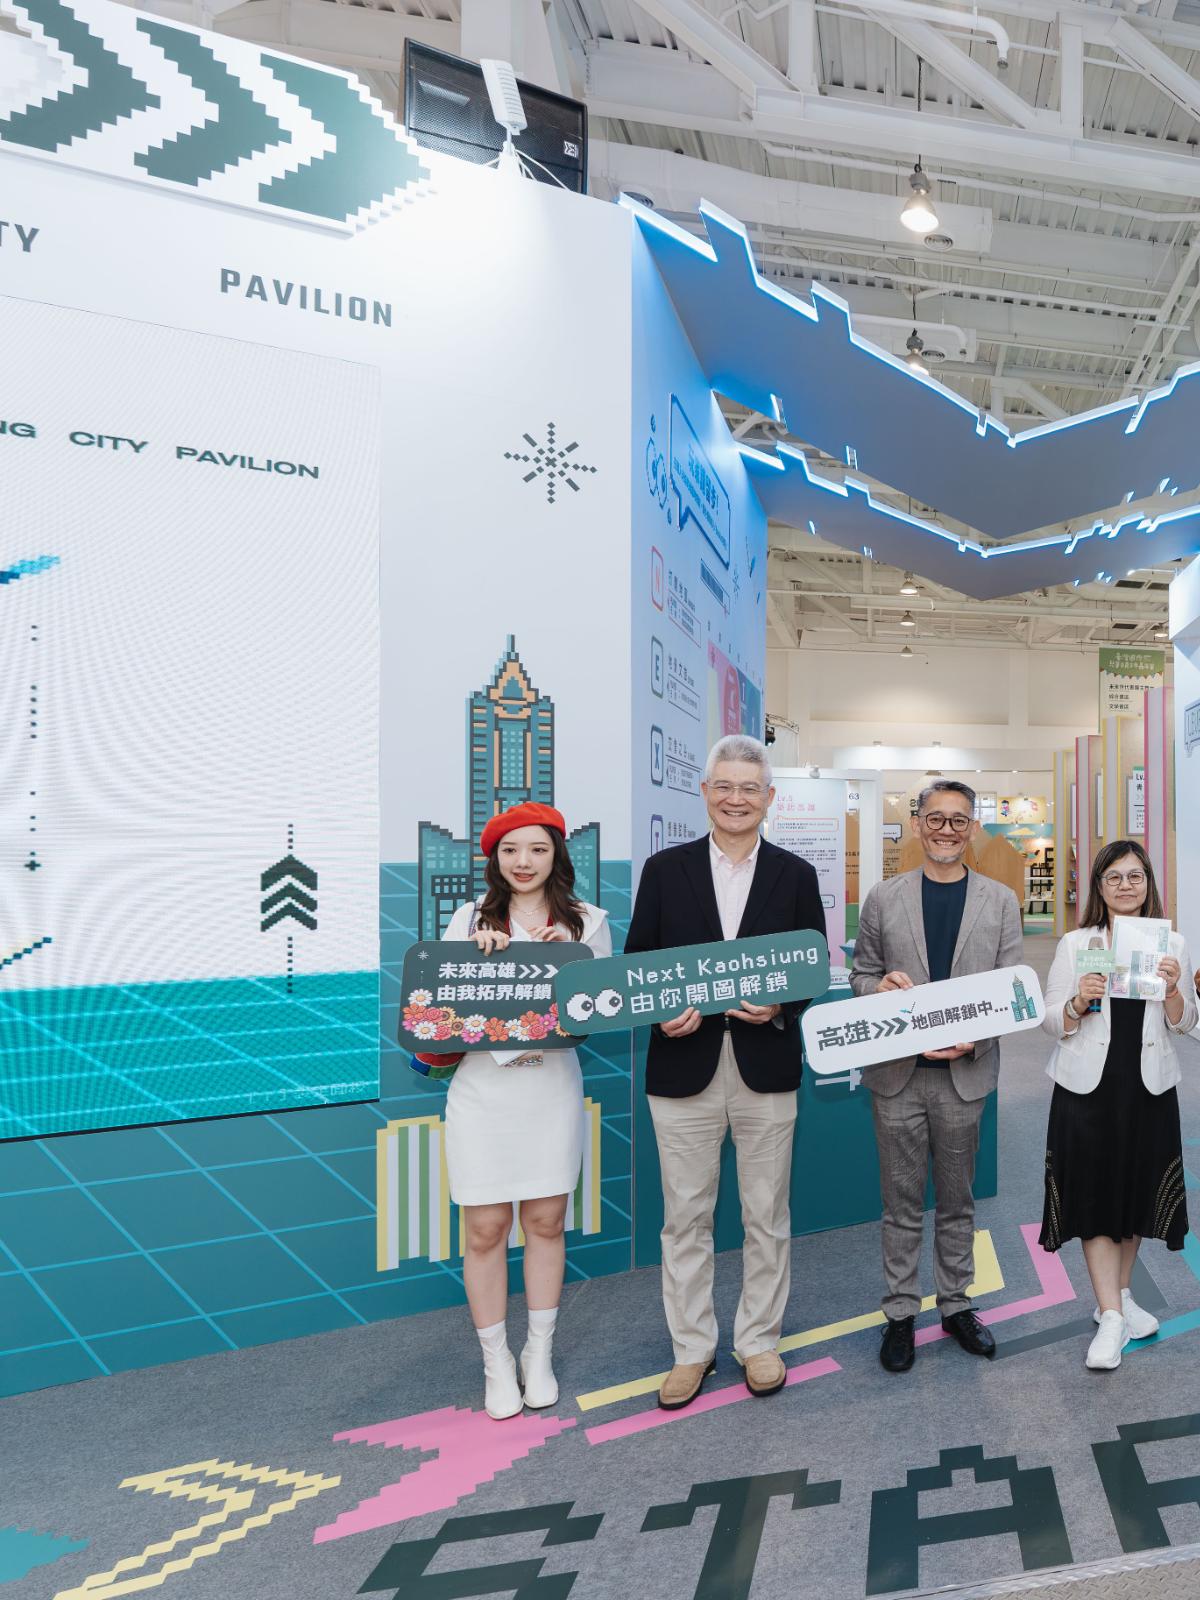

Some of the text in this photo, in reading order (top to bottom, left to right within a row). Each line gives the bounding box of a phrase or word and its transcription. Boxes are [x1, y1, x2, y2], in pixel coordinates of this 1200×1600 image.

[220, 268, 393, 327] PAVILION
[69, 431, 149, 453] CITY
[175, 446, 319, 479] PAVILION
[438, 962, 516, 979] 未來高雄
[626, 946, 818, 987] Next Kaohsiung
[437, 984, 552, 1002] 由我拓界解鎖
[630, 971, 789, 1015] 由你開圖解鎖
[817, 1018, 870, 1052] 高雄
